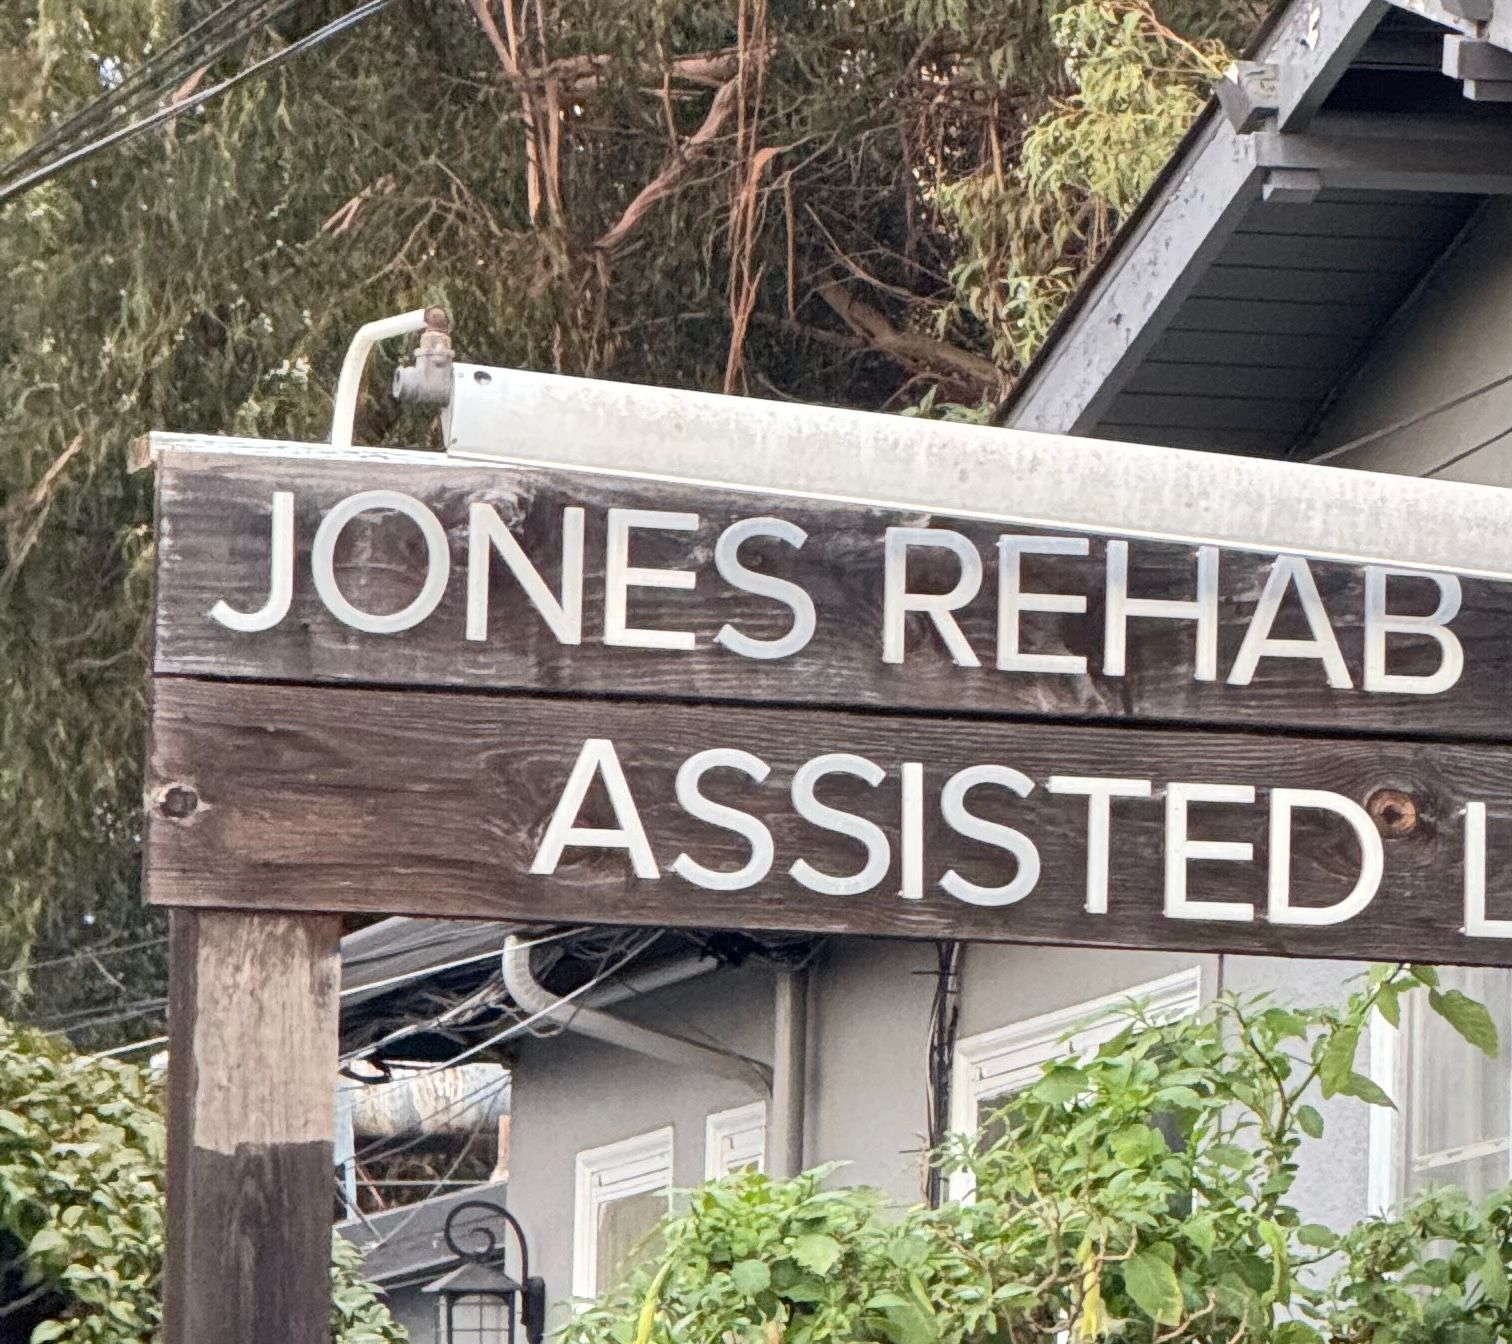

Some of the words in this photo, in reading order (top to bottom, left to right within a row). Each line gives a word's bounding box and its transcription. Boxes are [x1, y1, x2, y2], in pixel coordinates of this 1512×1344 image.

[211, 489, 818, 659] JONES
[882, 526, 1466, 697] REHAB
[529, 738, 1385, 926] ASSISTED
